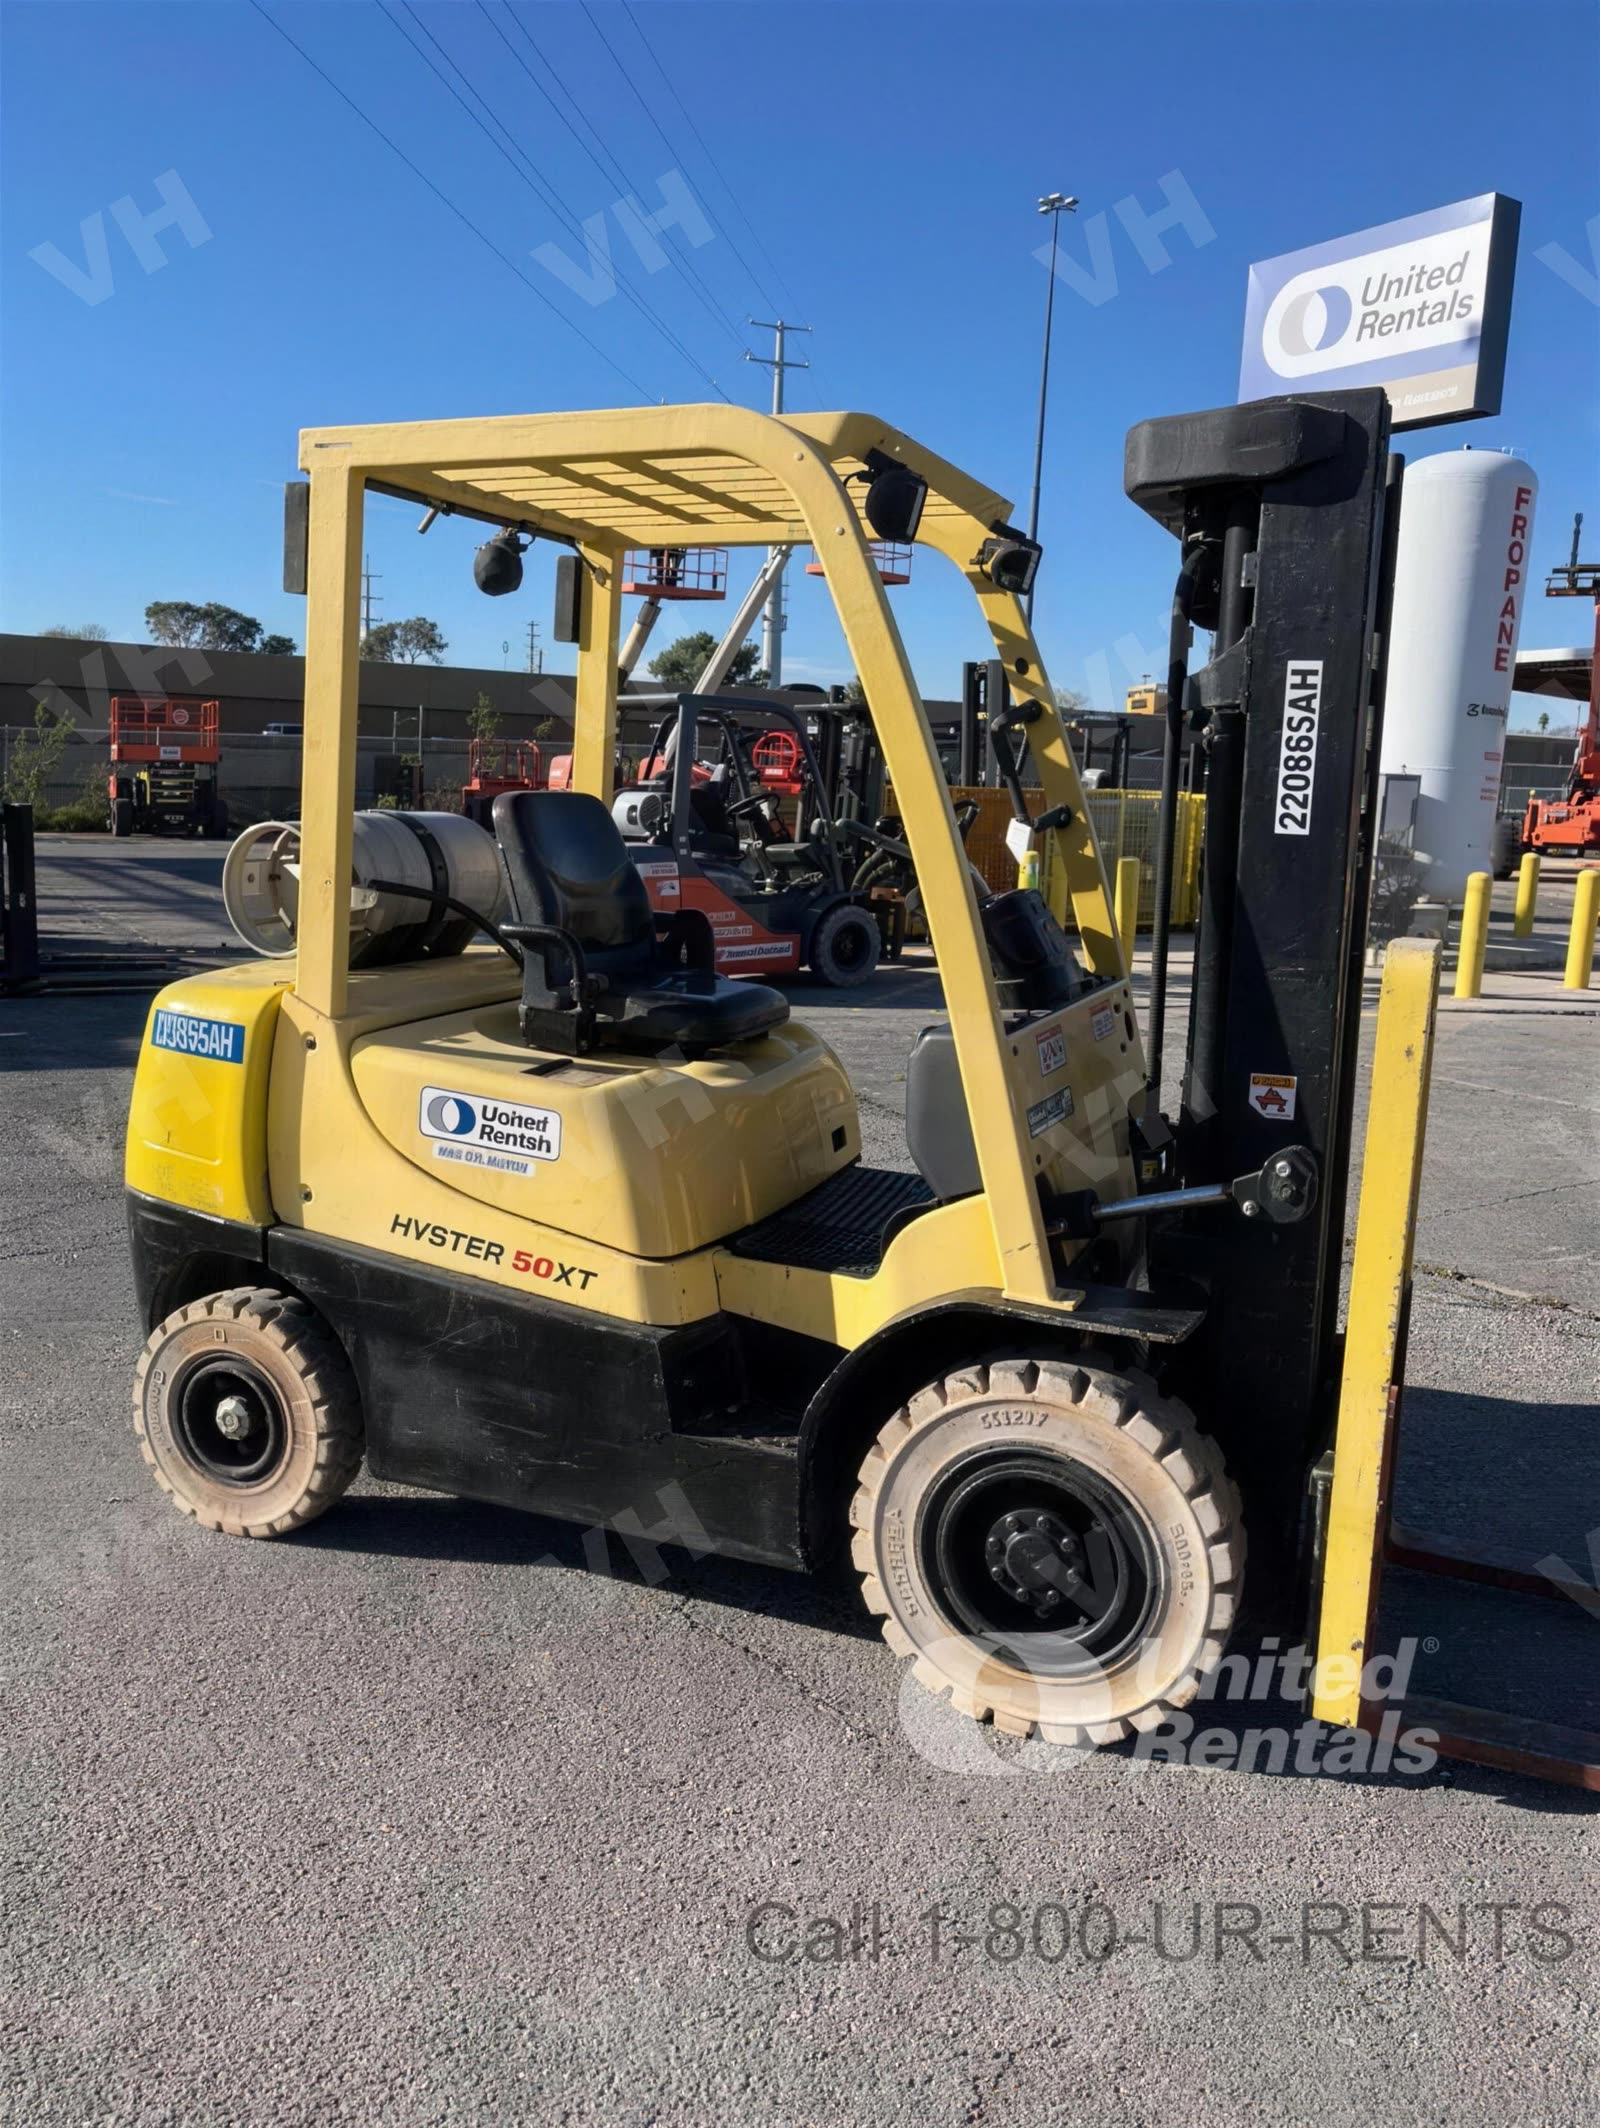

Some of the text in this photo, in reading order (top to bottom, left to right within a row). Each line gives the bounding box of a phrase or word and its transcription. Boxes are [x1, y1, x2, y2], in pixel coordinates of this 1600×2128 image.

[1361, 251, 1470, 307] United
[1356, 290, 1474, 342] Rentals
[1278, 668, 1320, 830] 22086SAH
